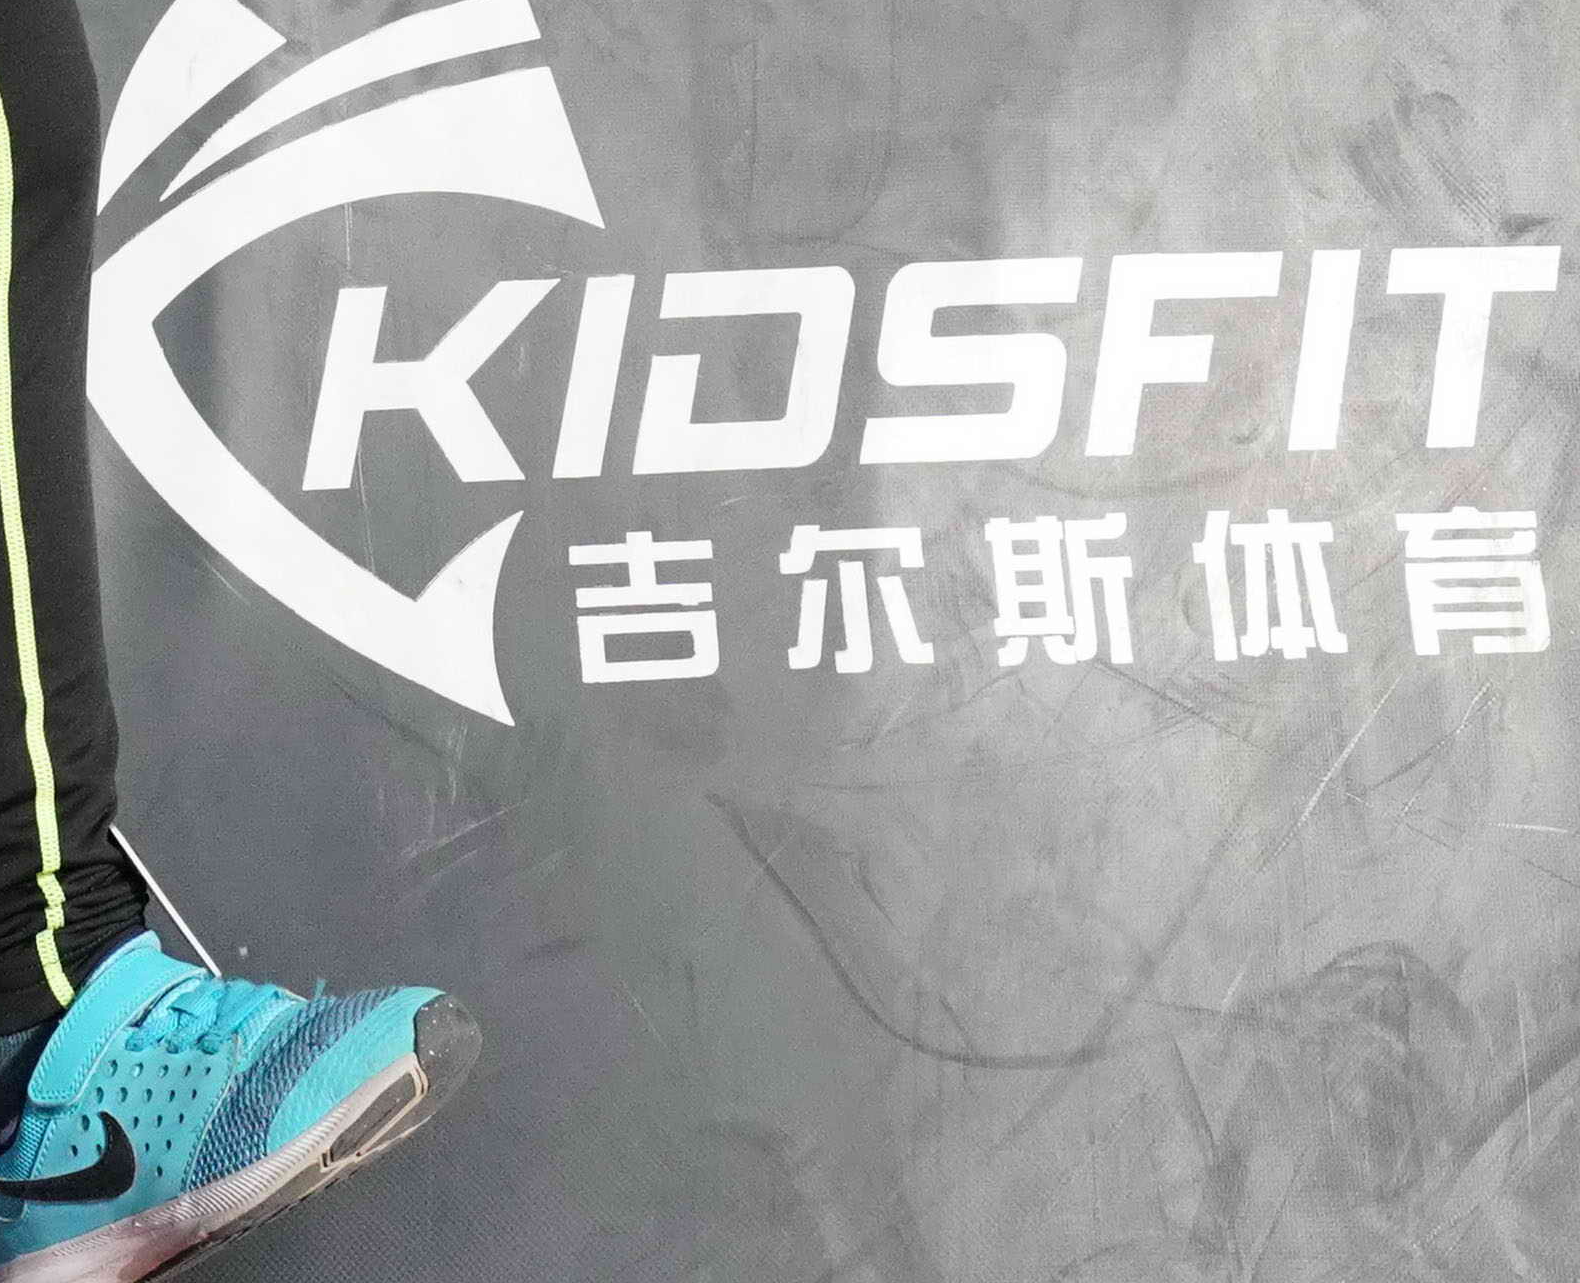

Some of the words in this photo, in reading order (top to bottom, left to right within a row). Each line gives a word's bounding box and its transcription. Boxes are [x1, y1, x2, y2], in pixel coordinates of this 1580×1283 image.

[302, 245, 1561, 492] KIDSFIT
[567, 507, 1550, 684] 吉尔斯体育
